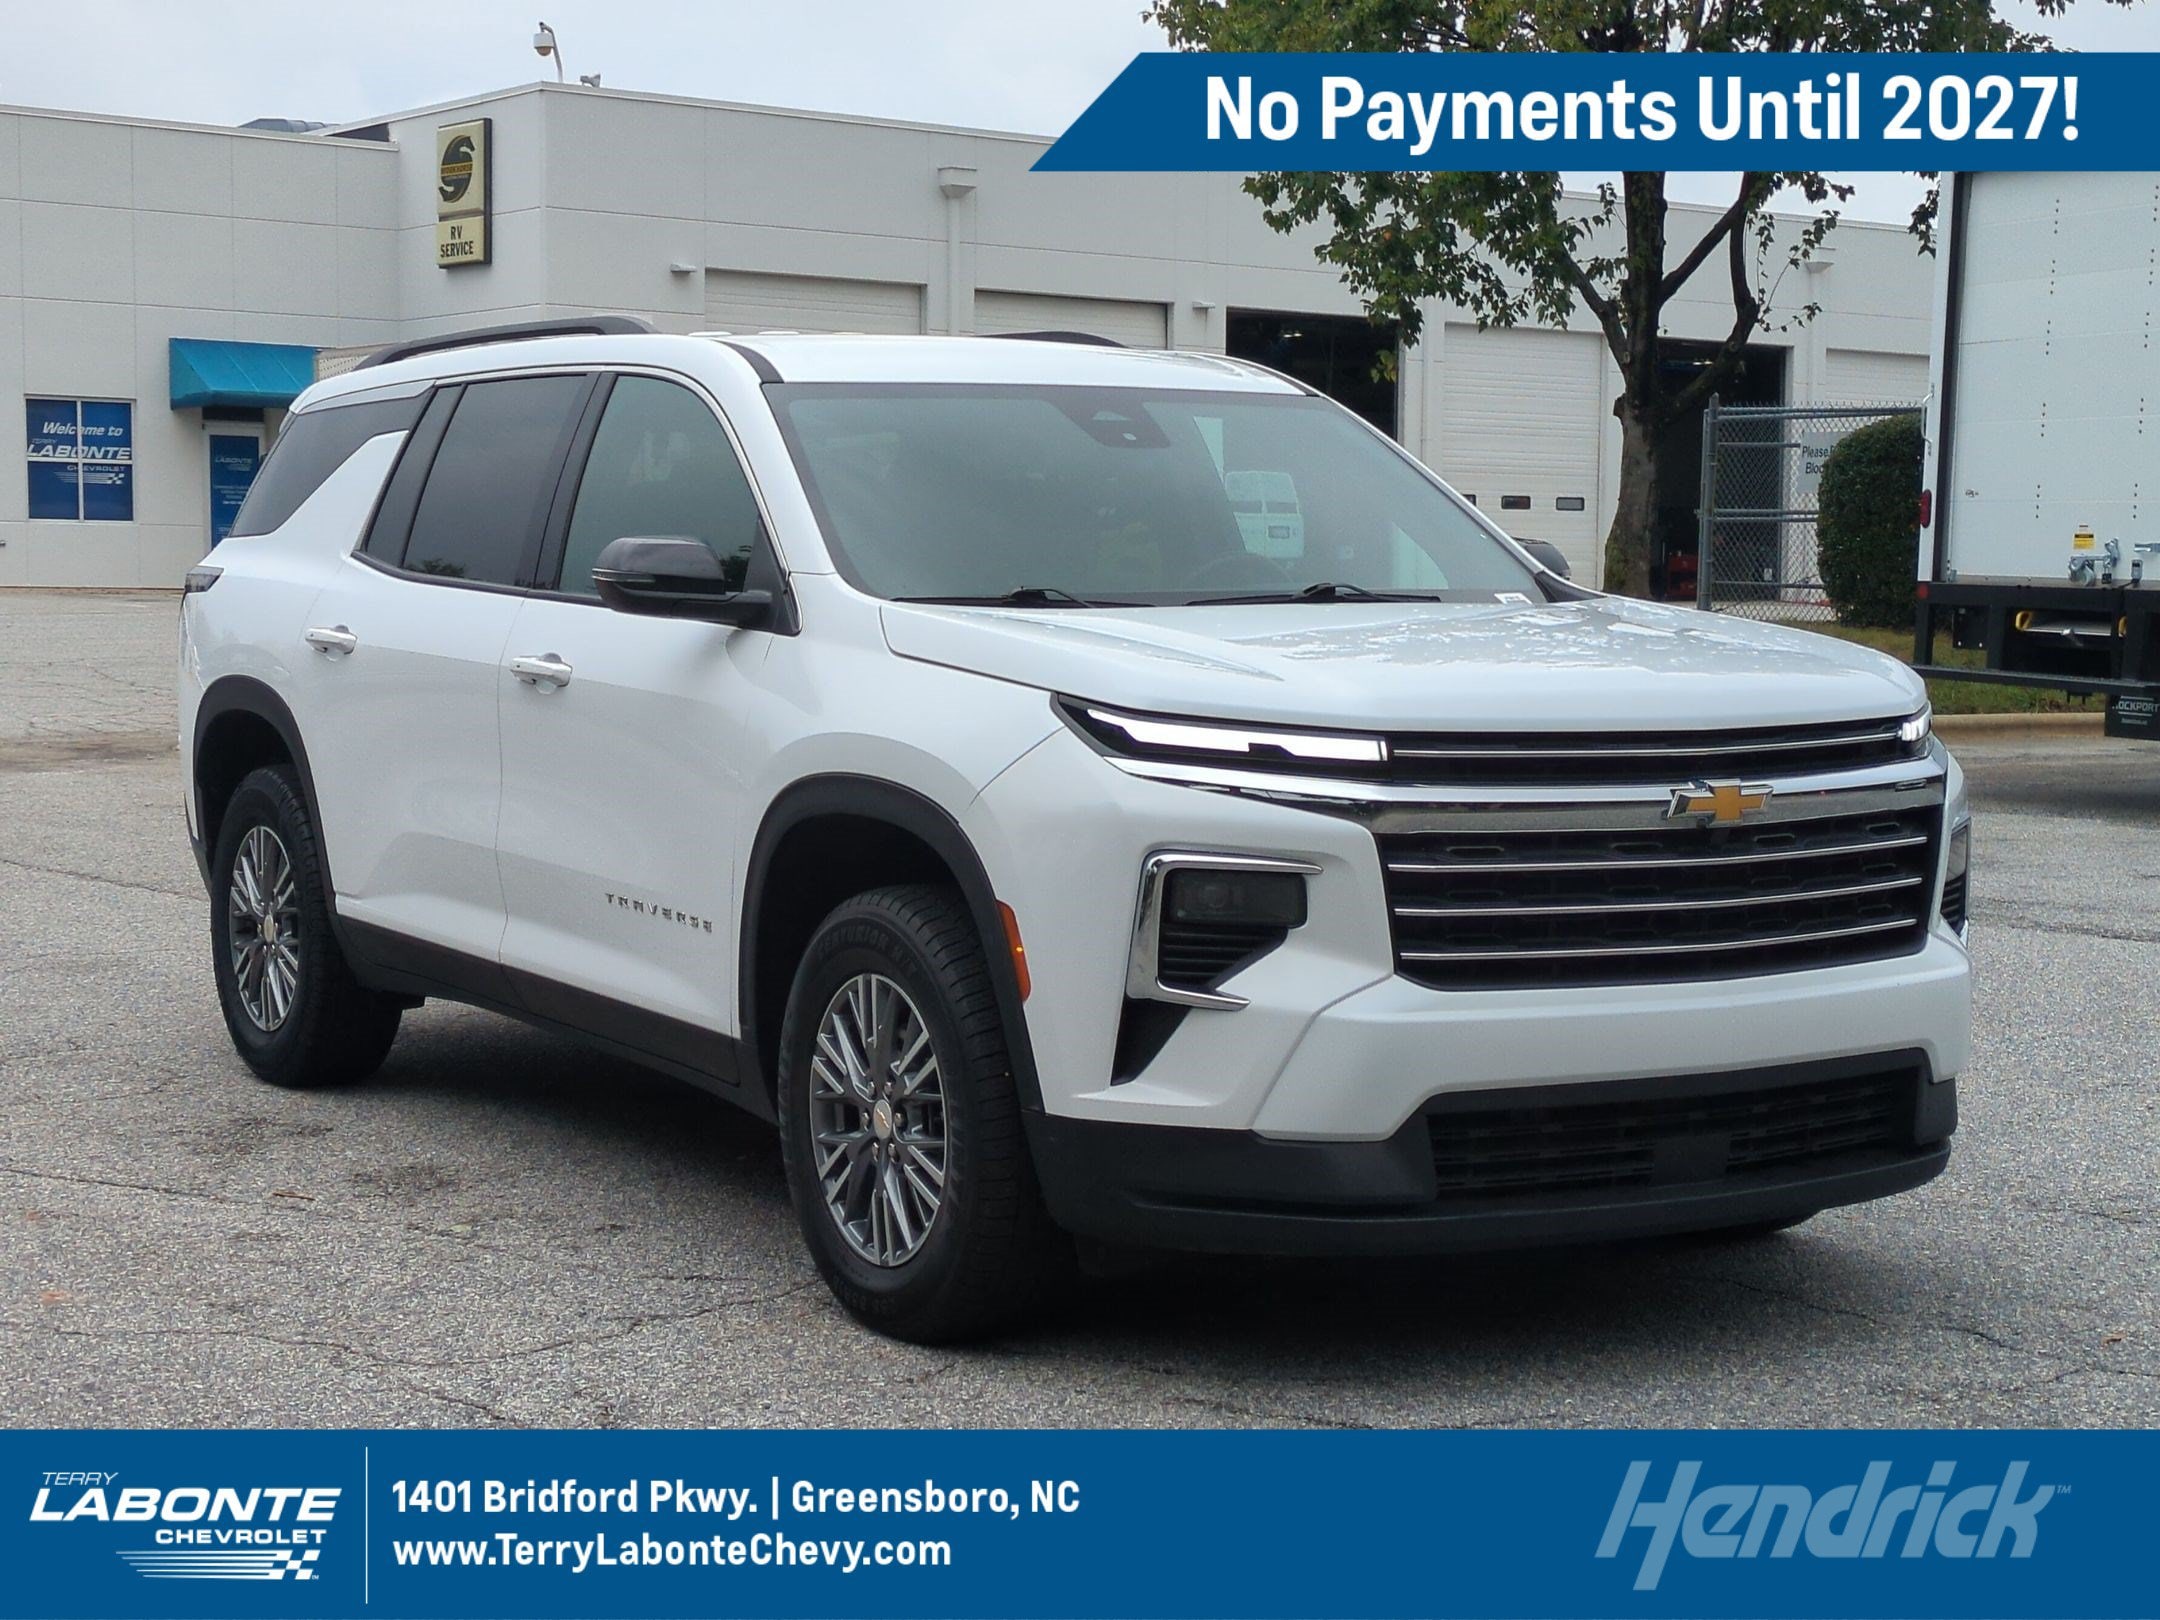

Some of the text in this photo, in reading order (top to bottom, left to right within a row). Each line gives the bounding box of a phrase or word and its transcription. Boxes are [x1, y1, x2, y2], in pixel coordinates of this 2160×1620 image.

[450, 226, 463, 240] RV
[440, 240, 474, 258] SERVICE
[107, 426, 123, 436] to
[27, 444, 131, 459] LABONTE
[1802, 446, 1828, 457] Please
[605, 892, 712, 933] TRAVERSE
